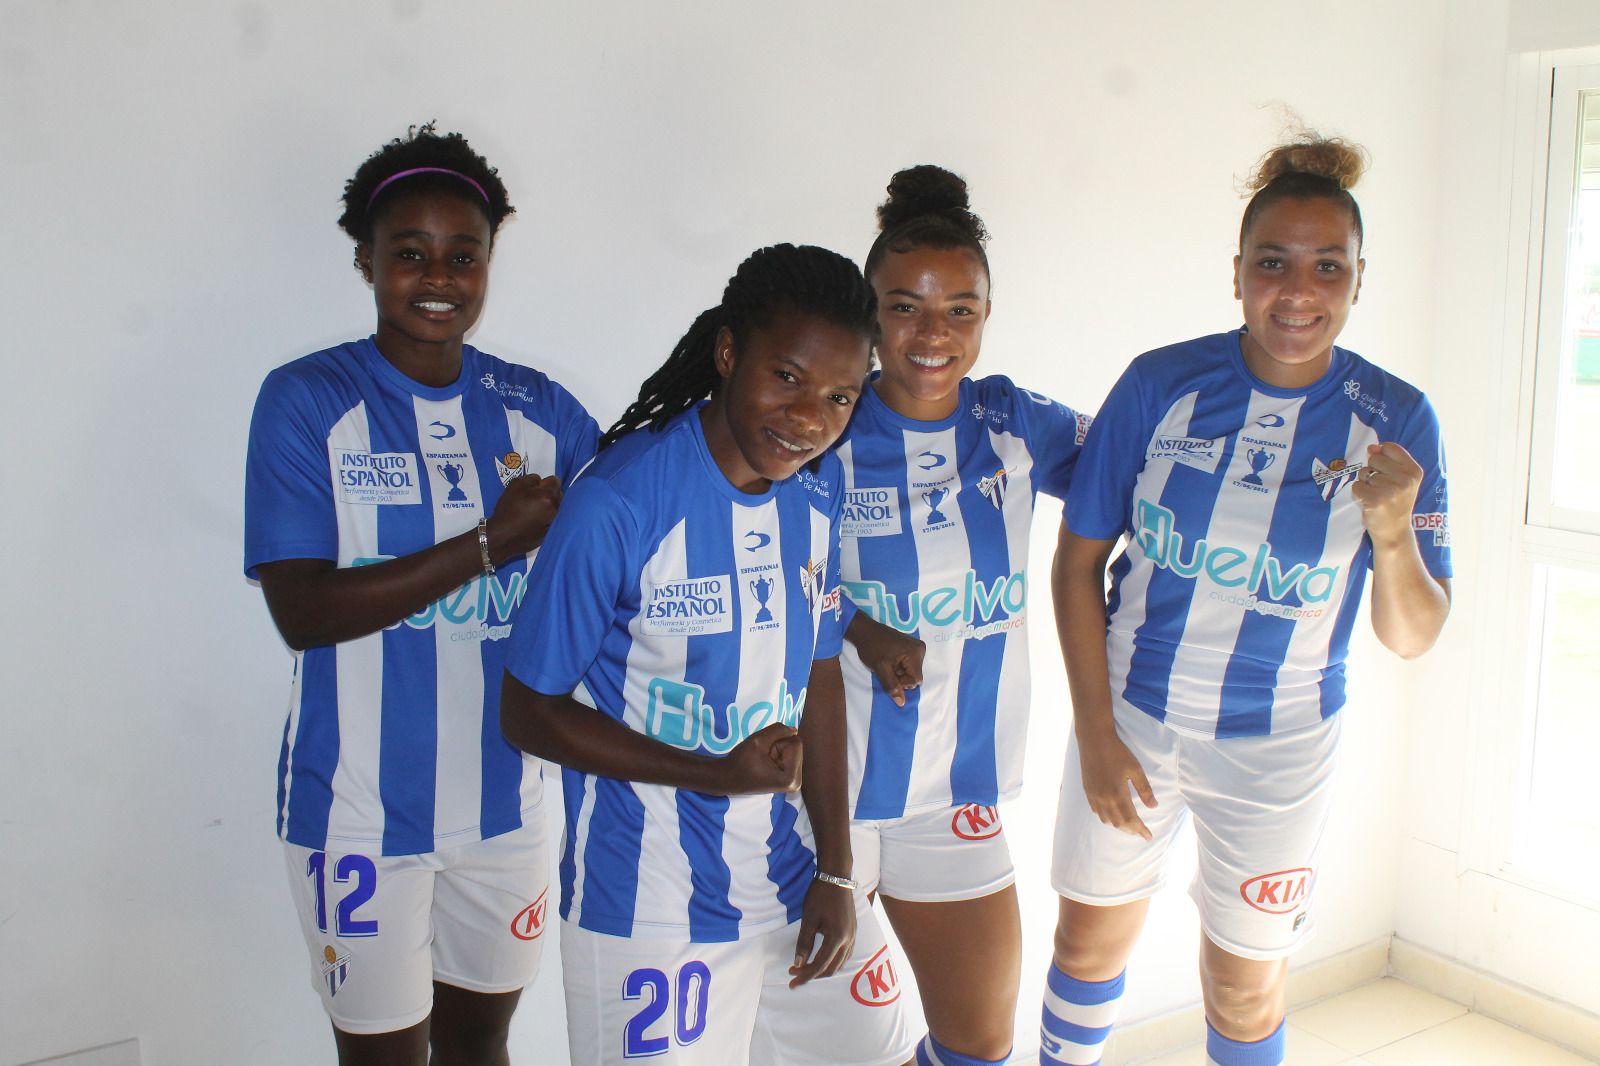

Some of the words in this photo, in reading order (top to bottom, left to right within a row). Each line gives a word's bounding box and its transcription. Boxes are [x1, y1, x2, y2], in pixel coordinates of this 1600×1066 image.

[1242, 436, 1287, 449] ESPARTANAS
[342, 453, 406, 469] INSTITUTO
[1136, 498, 1340, 602] Huelva
[654, 580, 721, 600] INSTITUTO
[646, 596, 726, 618] ESPAÑOL
[1209, 591, 1255, 609] ciudad
[1282, 607, 1323, 618] marca
[450, 625, 487, 642] ciudad
[488, 626, 511, 642] que
[687, 625, 705, 633] 1903
[963, 804, 999, 834] KI
[307, 851, 379, 937] 12
[866, 958, 898, 999] KI
[622, 960, 712, 1059] 20
